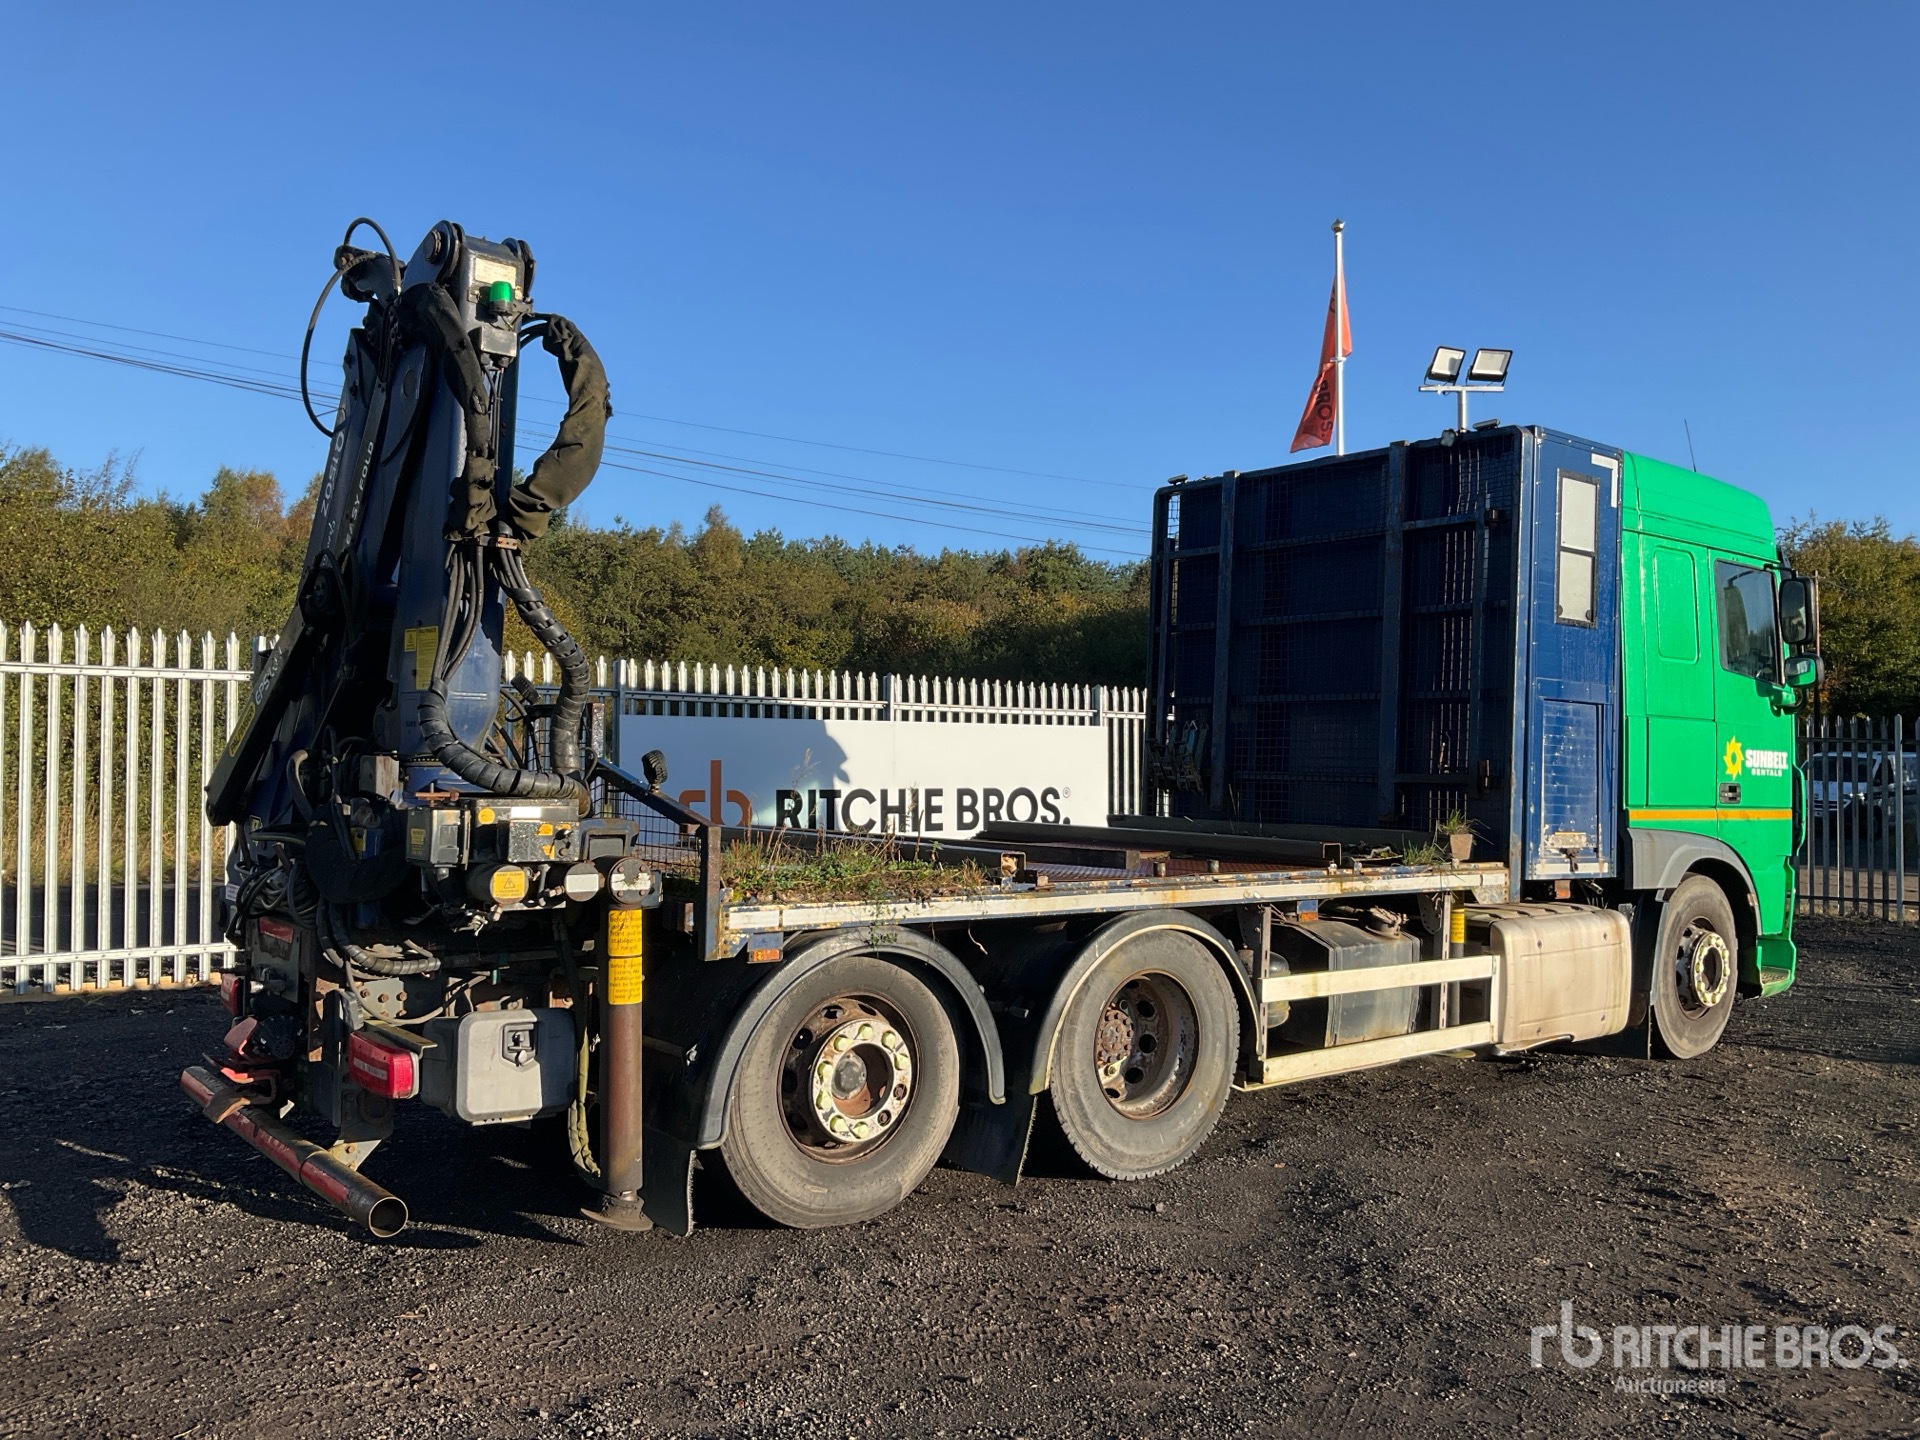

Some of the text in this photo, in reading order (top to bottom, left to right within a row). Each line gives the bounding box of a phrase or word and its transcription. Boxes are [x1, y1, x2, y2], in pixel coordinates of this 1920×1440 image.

[1745, 749, 1788, 770] SUNBELT
[1751, 768, 1783, 777] RENTALS
[776, 788, 943, 834] RITCHIE
